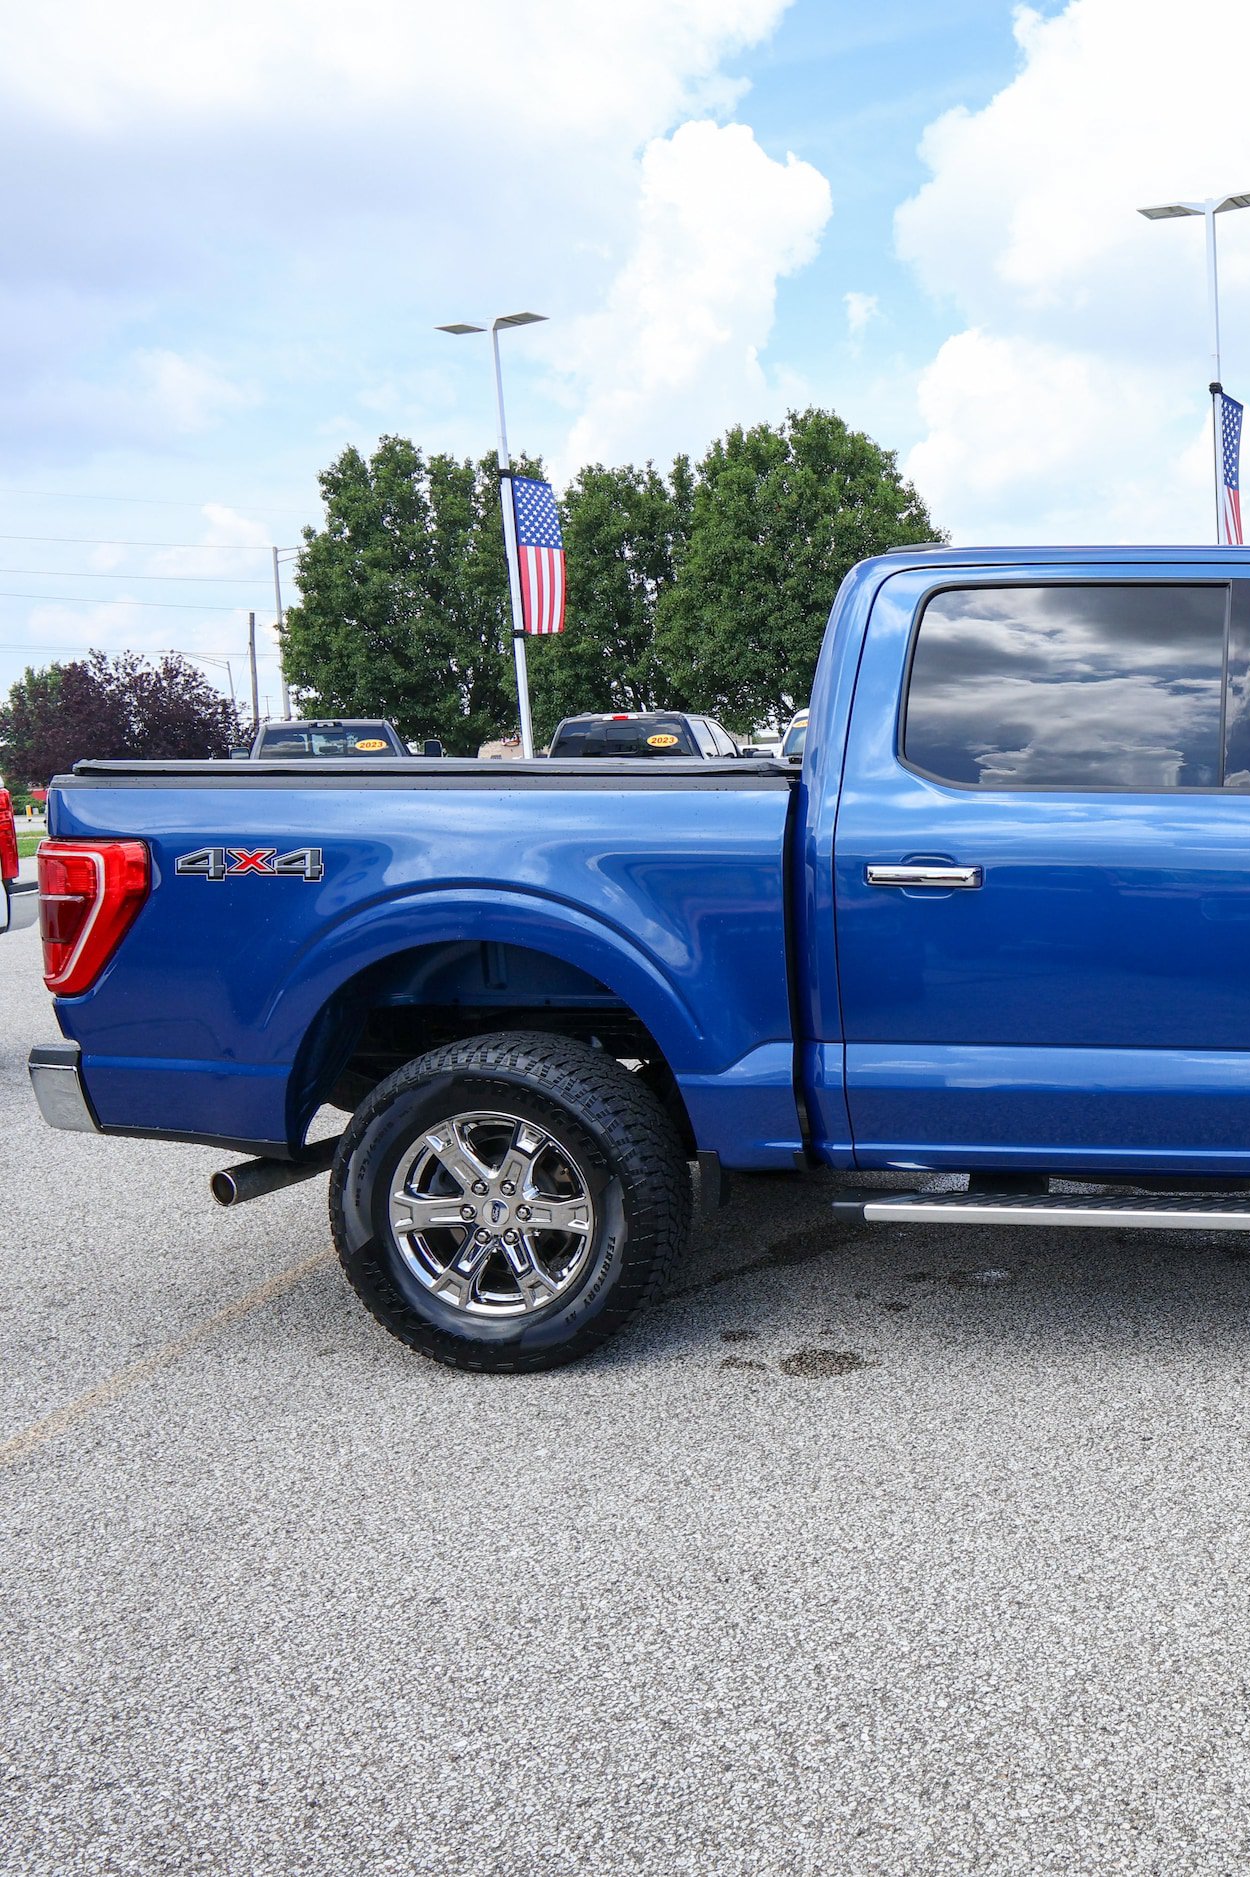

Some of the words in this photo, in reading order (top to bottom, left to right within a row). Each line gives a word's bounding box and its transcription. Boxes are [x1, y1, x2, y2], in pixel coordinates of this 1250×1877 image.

[651, 736, 675, 744] 2023
[360, 741, 383, 749] 2023
[582, 1235, 616, 1310] TERRITORY
